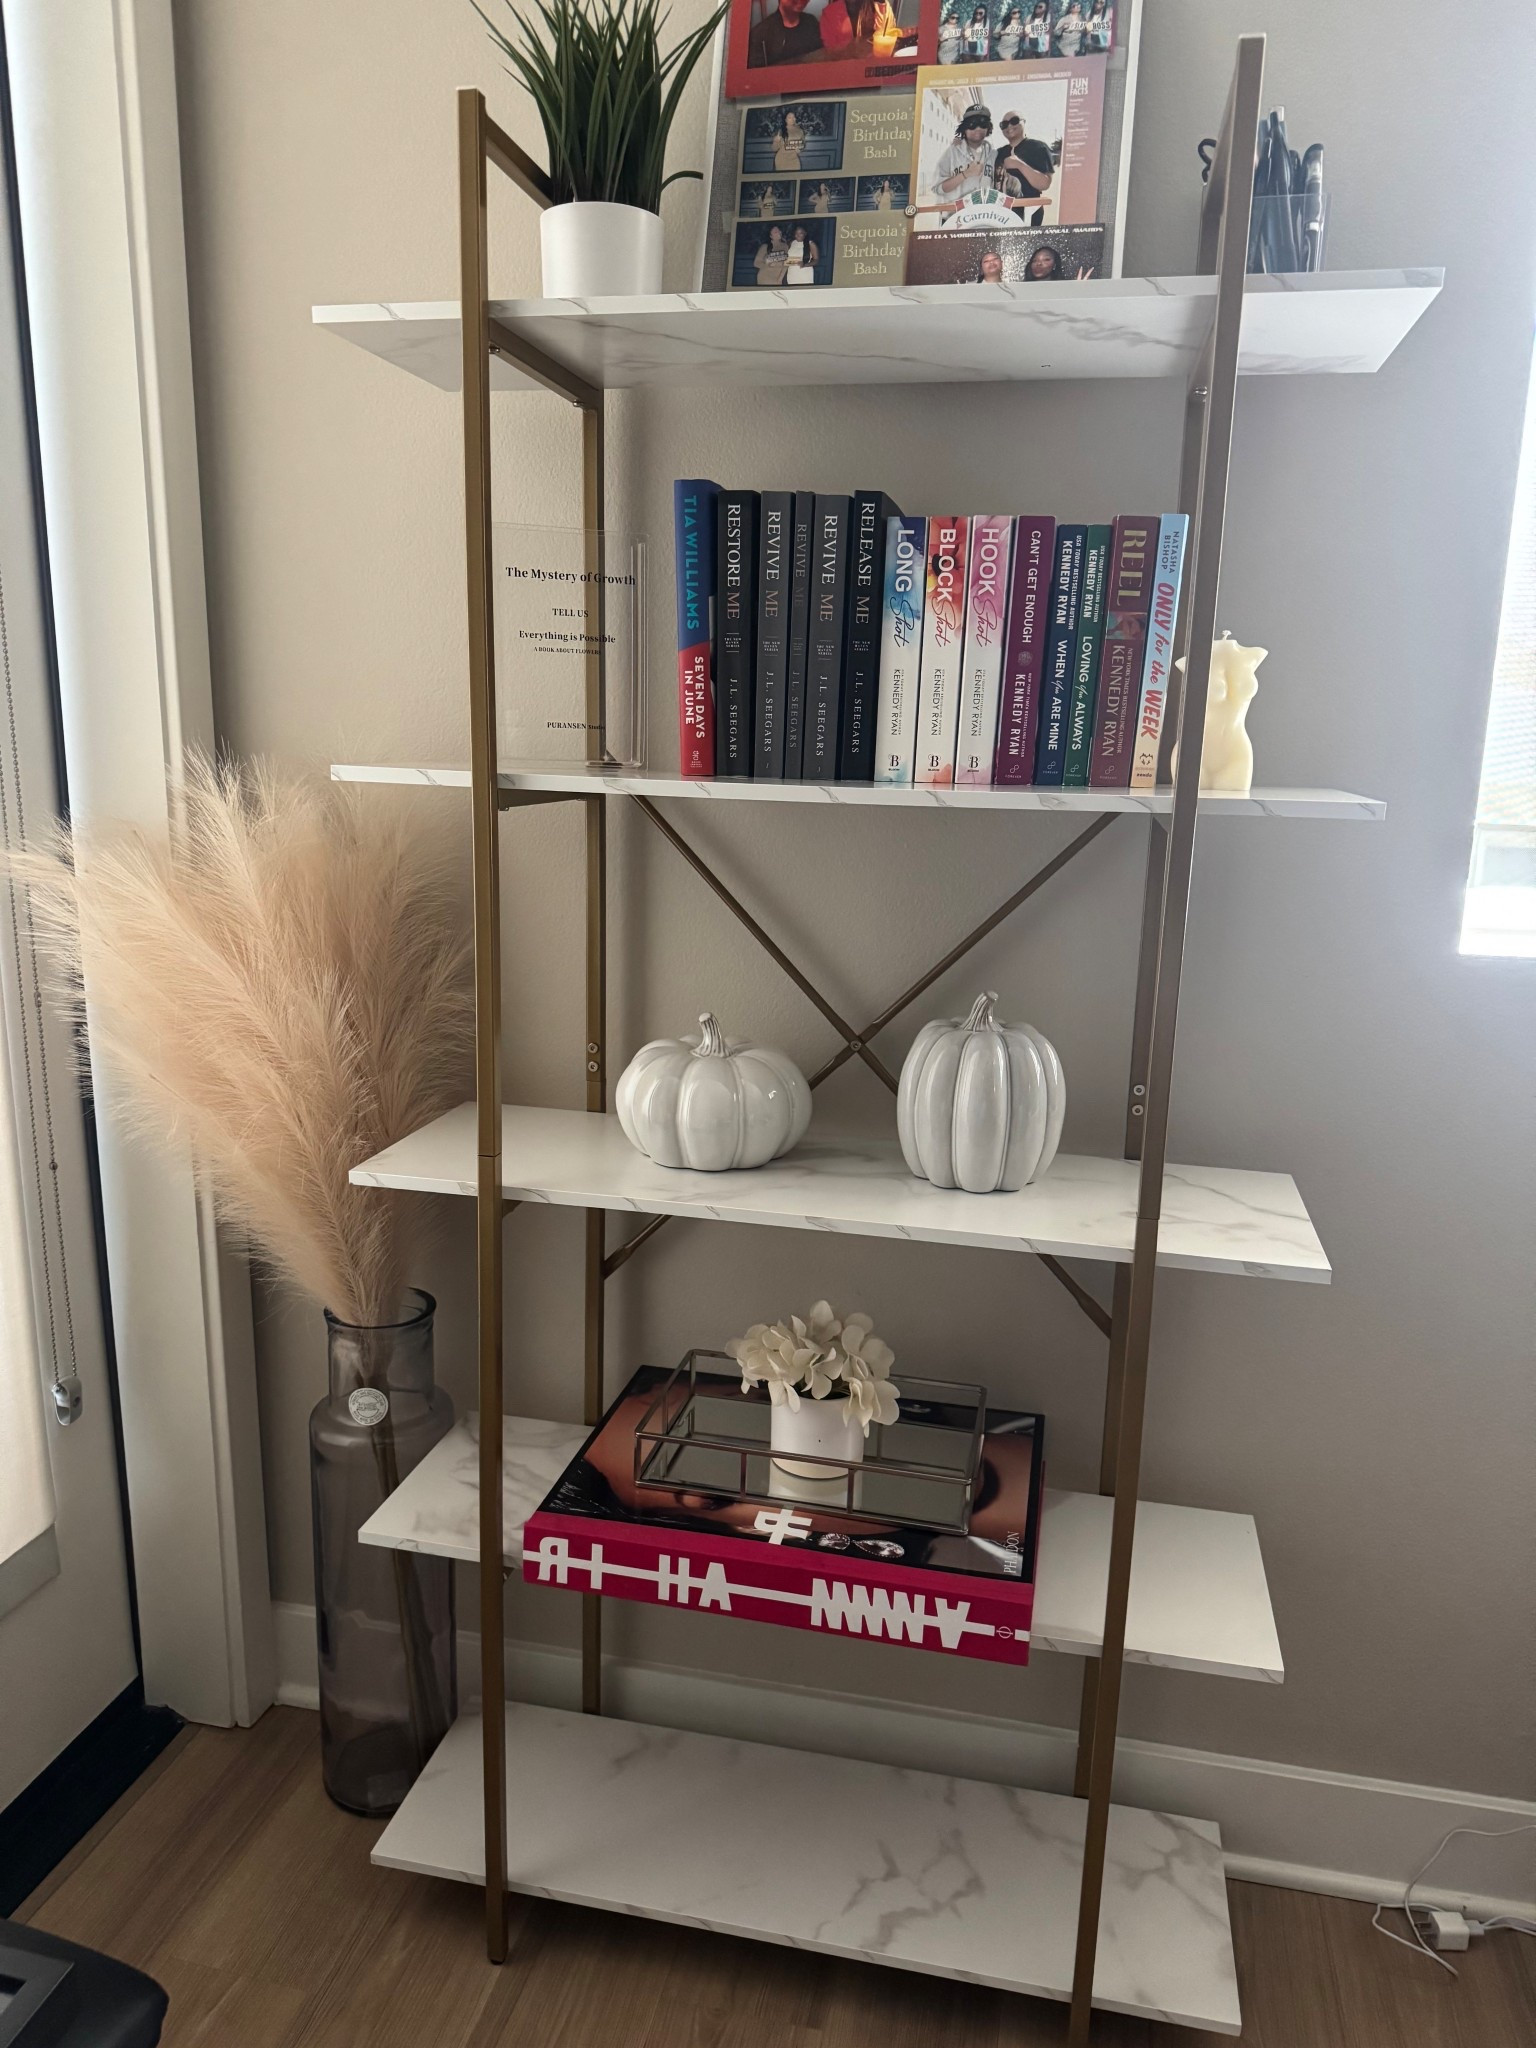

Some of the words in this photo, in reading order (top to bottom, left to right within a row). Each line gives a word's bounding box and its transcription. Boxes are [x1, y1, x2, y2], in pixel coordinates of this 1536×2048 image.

[970, 28, 988, 36] BOSS
[1030, 22, 1048, 32] BOSS
[1092, 21, 1110, 30] BOSS
[1070, 78, 1088, 88] FUN
[1070, 88, 1088, 96] FACTS
[852, 126, 912, 142] Birthday
[864, 144, 897, 159] Bash
[840, 223, 908, 242] Sequoia's
[962, 210, 1010, 225] Carnival
[842, 242, 904, 258] Birthday
[854, 262, 887, 275] Bash
[684, 495, 697, 528] TIA
[728, 504, 741, 587] RESTORE
[766, 511, 781, 580] REVIVE
[795, 524, 807, 577] REVIVE
[821, 515, 838, 584] REVIVE
[858, 502, 875, 586] RELEASE
[895, 529, 915, 593] LONG
[1029, 530, 1041, 565] CAN'T
[1161, 535, 1172, 570] BISHOP
[1168, 531, 1180, 574] NATASHA
[505, 566, 529, 578] The
[531, 568, 578, 584] Mystery
[580, 571, 592, 582] of
[593, 573, 636, 585] Growth
[936, 528, 956, 603] BLOCK
[977, 528, 1000, 596] HOOK
[1058, 540, 1073, 591] KENNEDY
[1085, 549, 1098, 591] KENNEDY
[1116, 530, 1148, 606] REEL
[686, 532, 700, 630] WILLIAMS
[1027, 568, 1038, 591] GET
[1070, 569, 1079, 606] BESTSELLING
[552, 608, 576, 617] TELL
[577, 610, 589, 618] US
[727, 592, 740, 619] ME
[765, 590, 778, 618] ME
[820, 594, 834, 621] ME
[856, 596, 870, 624] ME
[1022, 594, 1036, 643] ENOUGH
[1056, 595, 1068, 624] RYAN
[1068, 607, 1076, 630] AUTHOR
[1083, 594, 1094, 618] RYAN
[1154, 582, 1175, 631] ONLY
[519, 630, 569, 642] Everything
[570, 632, 578, 641] is
[579, 633, 616, 643] Possible
[890, 597, 915, 648] Shot
[931, 596, 956, 648] Shot
[972, 595, 998, 648] Shot
[1055, 640, 1068, 678] WHEN
[1079, 636, 1093, 683] LOVING
[1154, 632, 1170, 656] for
[684, 670, 694, 684] IN
[694, 656, 704, 700] SEVEN
[730, 678, 738, 699] J.L.
[766, 671, 774, 692] J.L.
[819, 676, 827, 696] J.L.
[855, 672, 864, 693] J.L.
[892, 668, 900, 710] KENNEDY
[932, 668, 942, 710] KENNEDY
[1106, 645, 1126, 716] KENNEDY
[1150, 660, 1166, 685] the
[685, 690, 694, 724] JUNE
[972, 669, 982, 711] KENNEDY
[1011, 674, 1026, 724] KENNEDY
[696, 705, 705, 739] DAYS
[764, 698, 773, 752] SEEGARS
[789, 696, 799, 748] SEEGARS
[891, 712, 899, 736] RYAN
[931, 712, 940, 736] RYAN
[971, 713, 979, 736] RYAN
[1050, 697, 1062, 720] ARE
[1072, 701, 1086, 750] ALWAYS
[1140, 689, 1163, 740] WEEK
[729, 705, 738, 758] SEEGARS
[816, 702, 826, 756] SEEGARS
[852, 699, 862, 753] SEEGARS
[1008, 728, 1021, 755] RYAN
[1048, 722, 1060, 750] MINE
[1101, 721, 1117, 757] RYAN
[1003, 1530, 1020, 1574] PHAIDON
